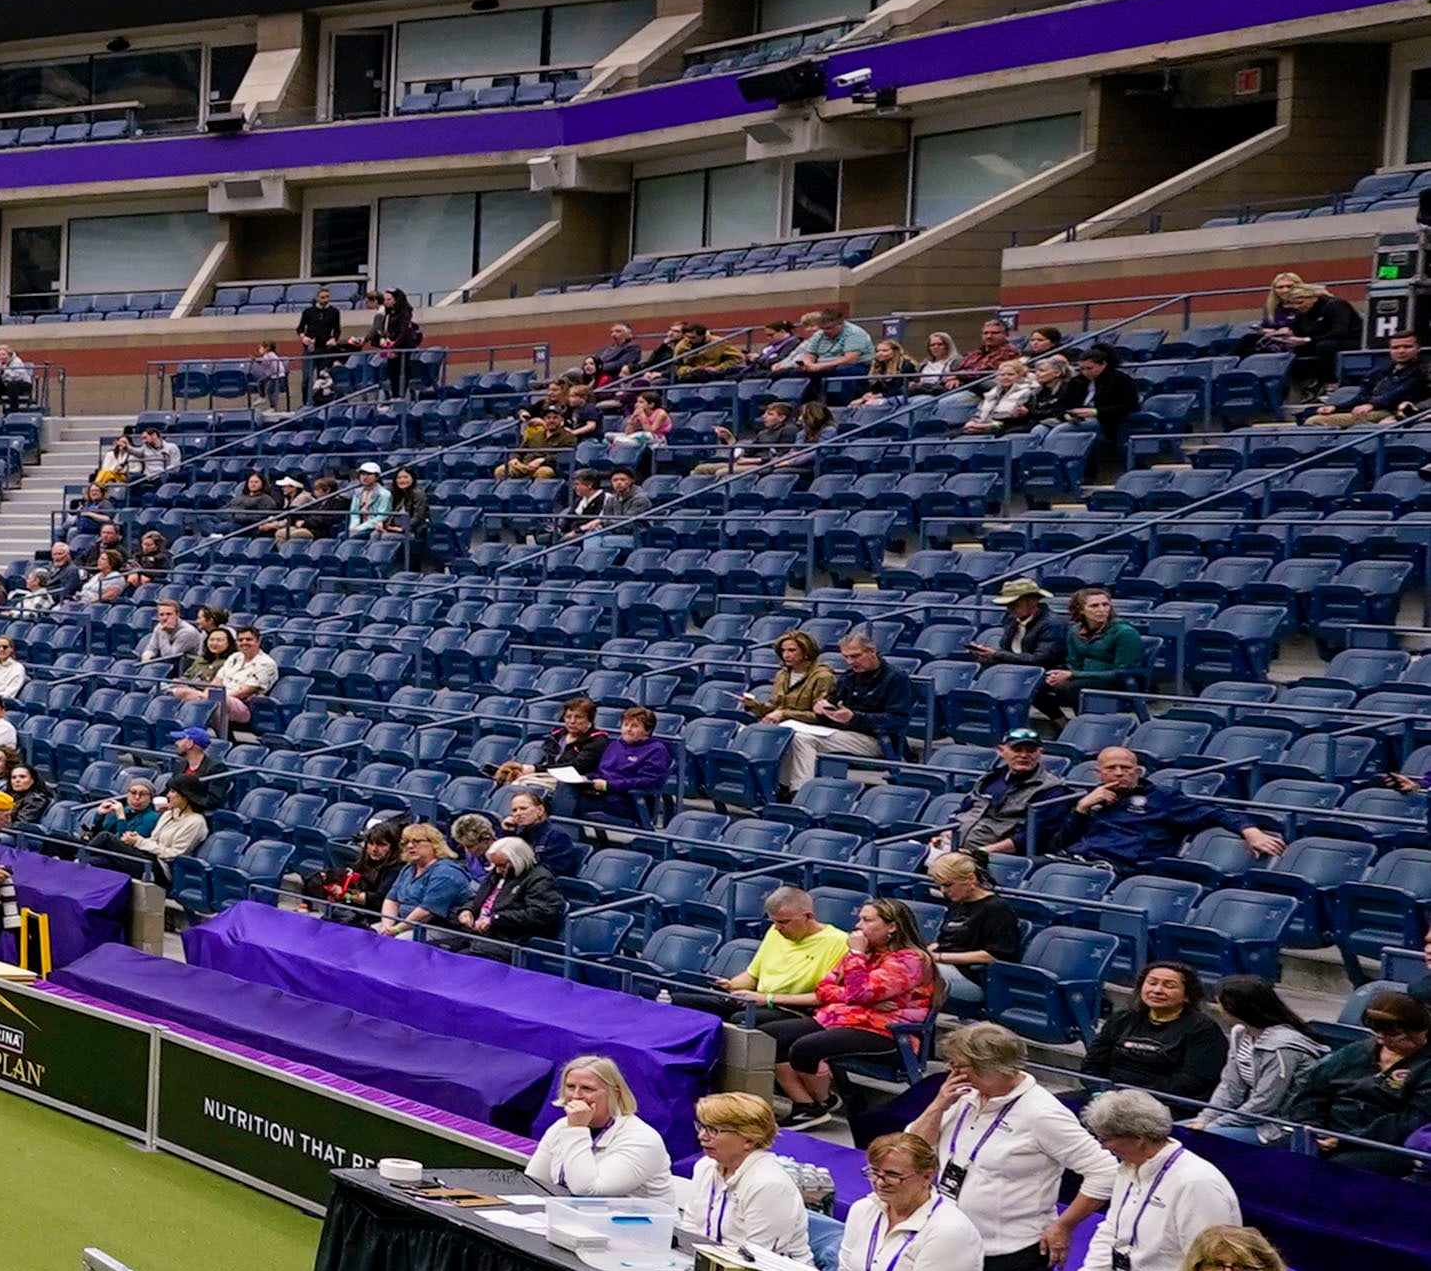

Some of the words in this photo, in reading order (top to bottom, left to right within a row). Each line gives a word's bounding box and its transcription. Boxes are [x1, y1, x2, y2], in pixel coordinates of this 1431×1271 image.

[1375, 316, 1399, 337] H
[203, 1096, 295, 1148] NUTRITION
[299, 1133, 347, 1168] THAT
